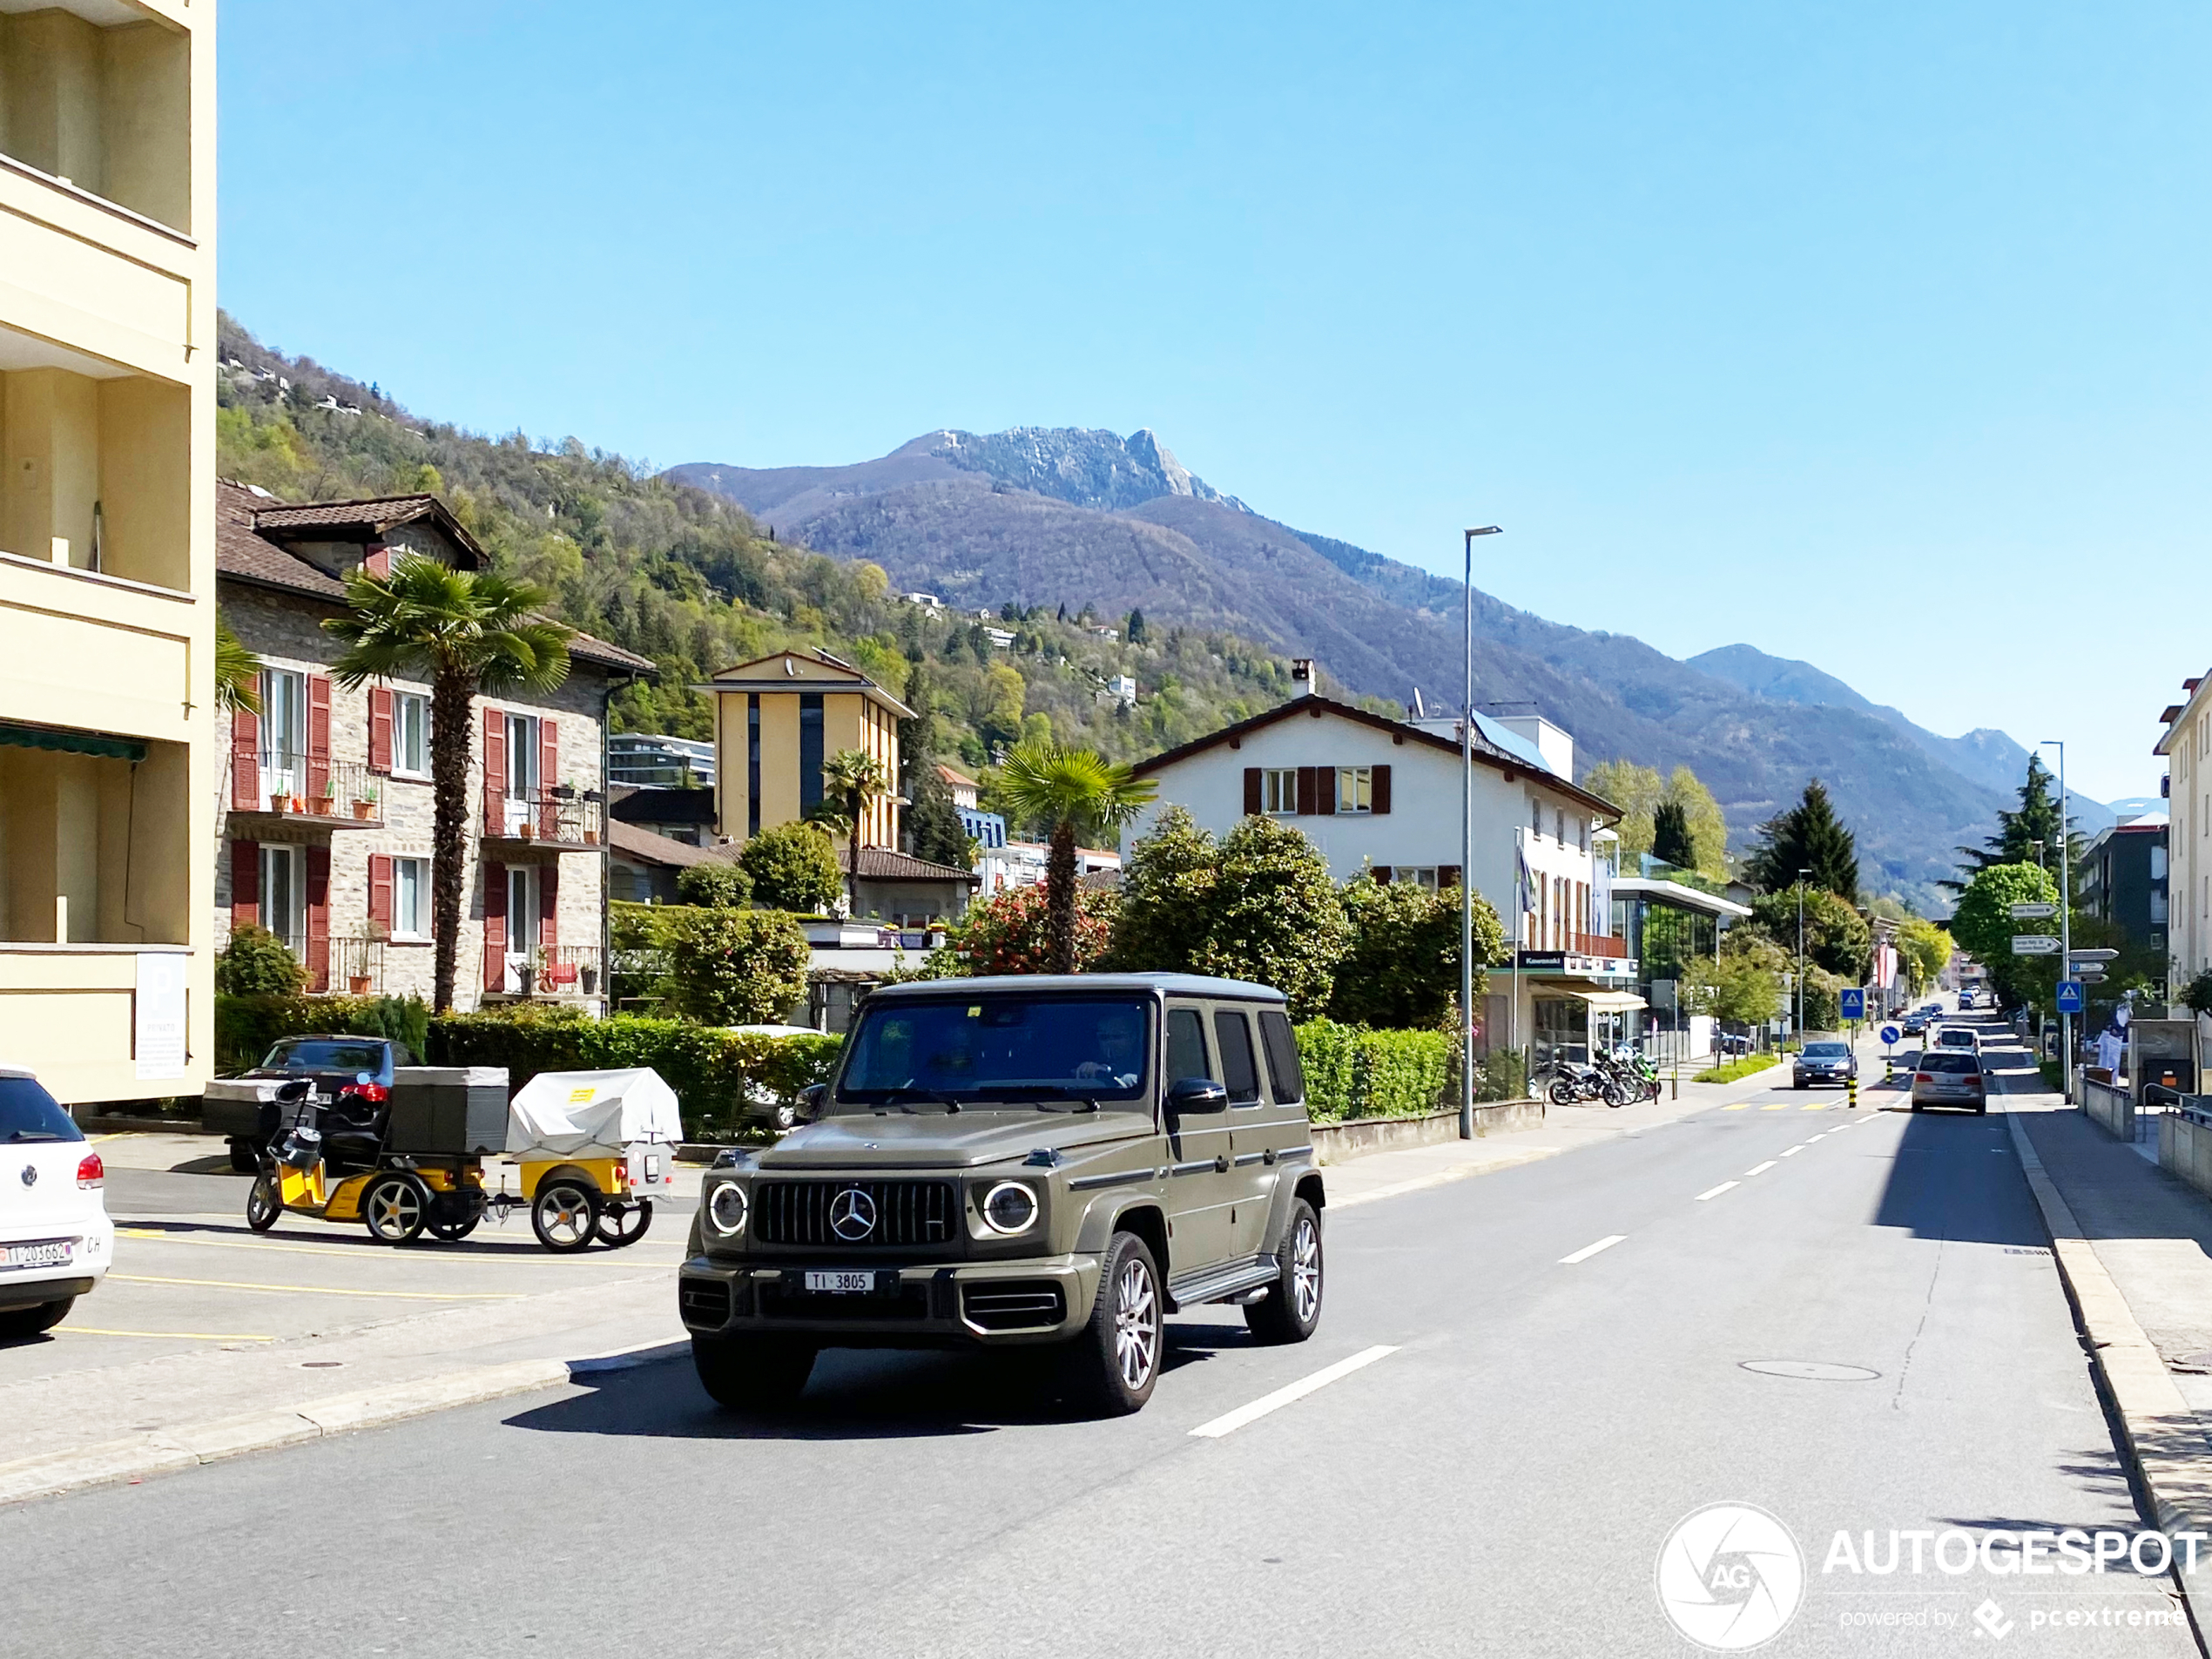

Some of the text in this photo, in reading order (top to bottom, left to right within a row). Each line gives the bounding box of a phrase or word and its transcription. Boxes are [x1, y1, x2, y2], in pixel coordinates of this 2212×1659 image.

[151, 965, 172, 1010] P
[146, 1023, 176, 1033] PRIVATO
[87, 1237, 101, 1254] CH
[813, 1274, 866, 1289] TI 3805
